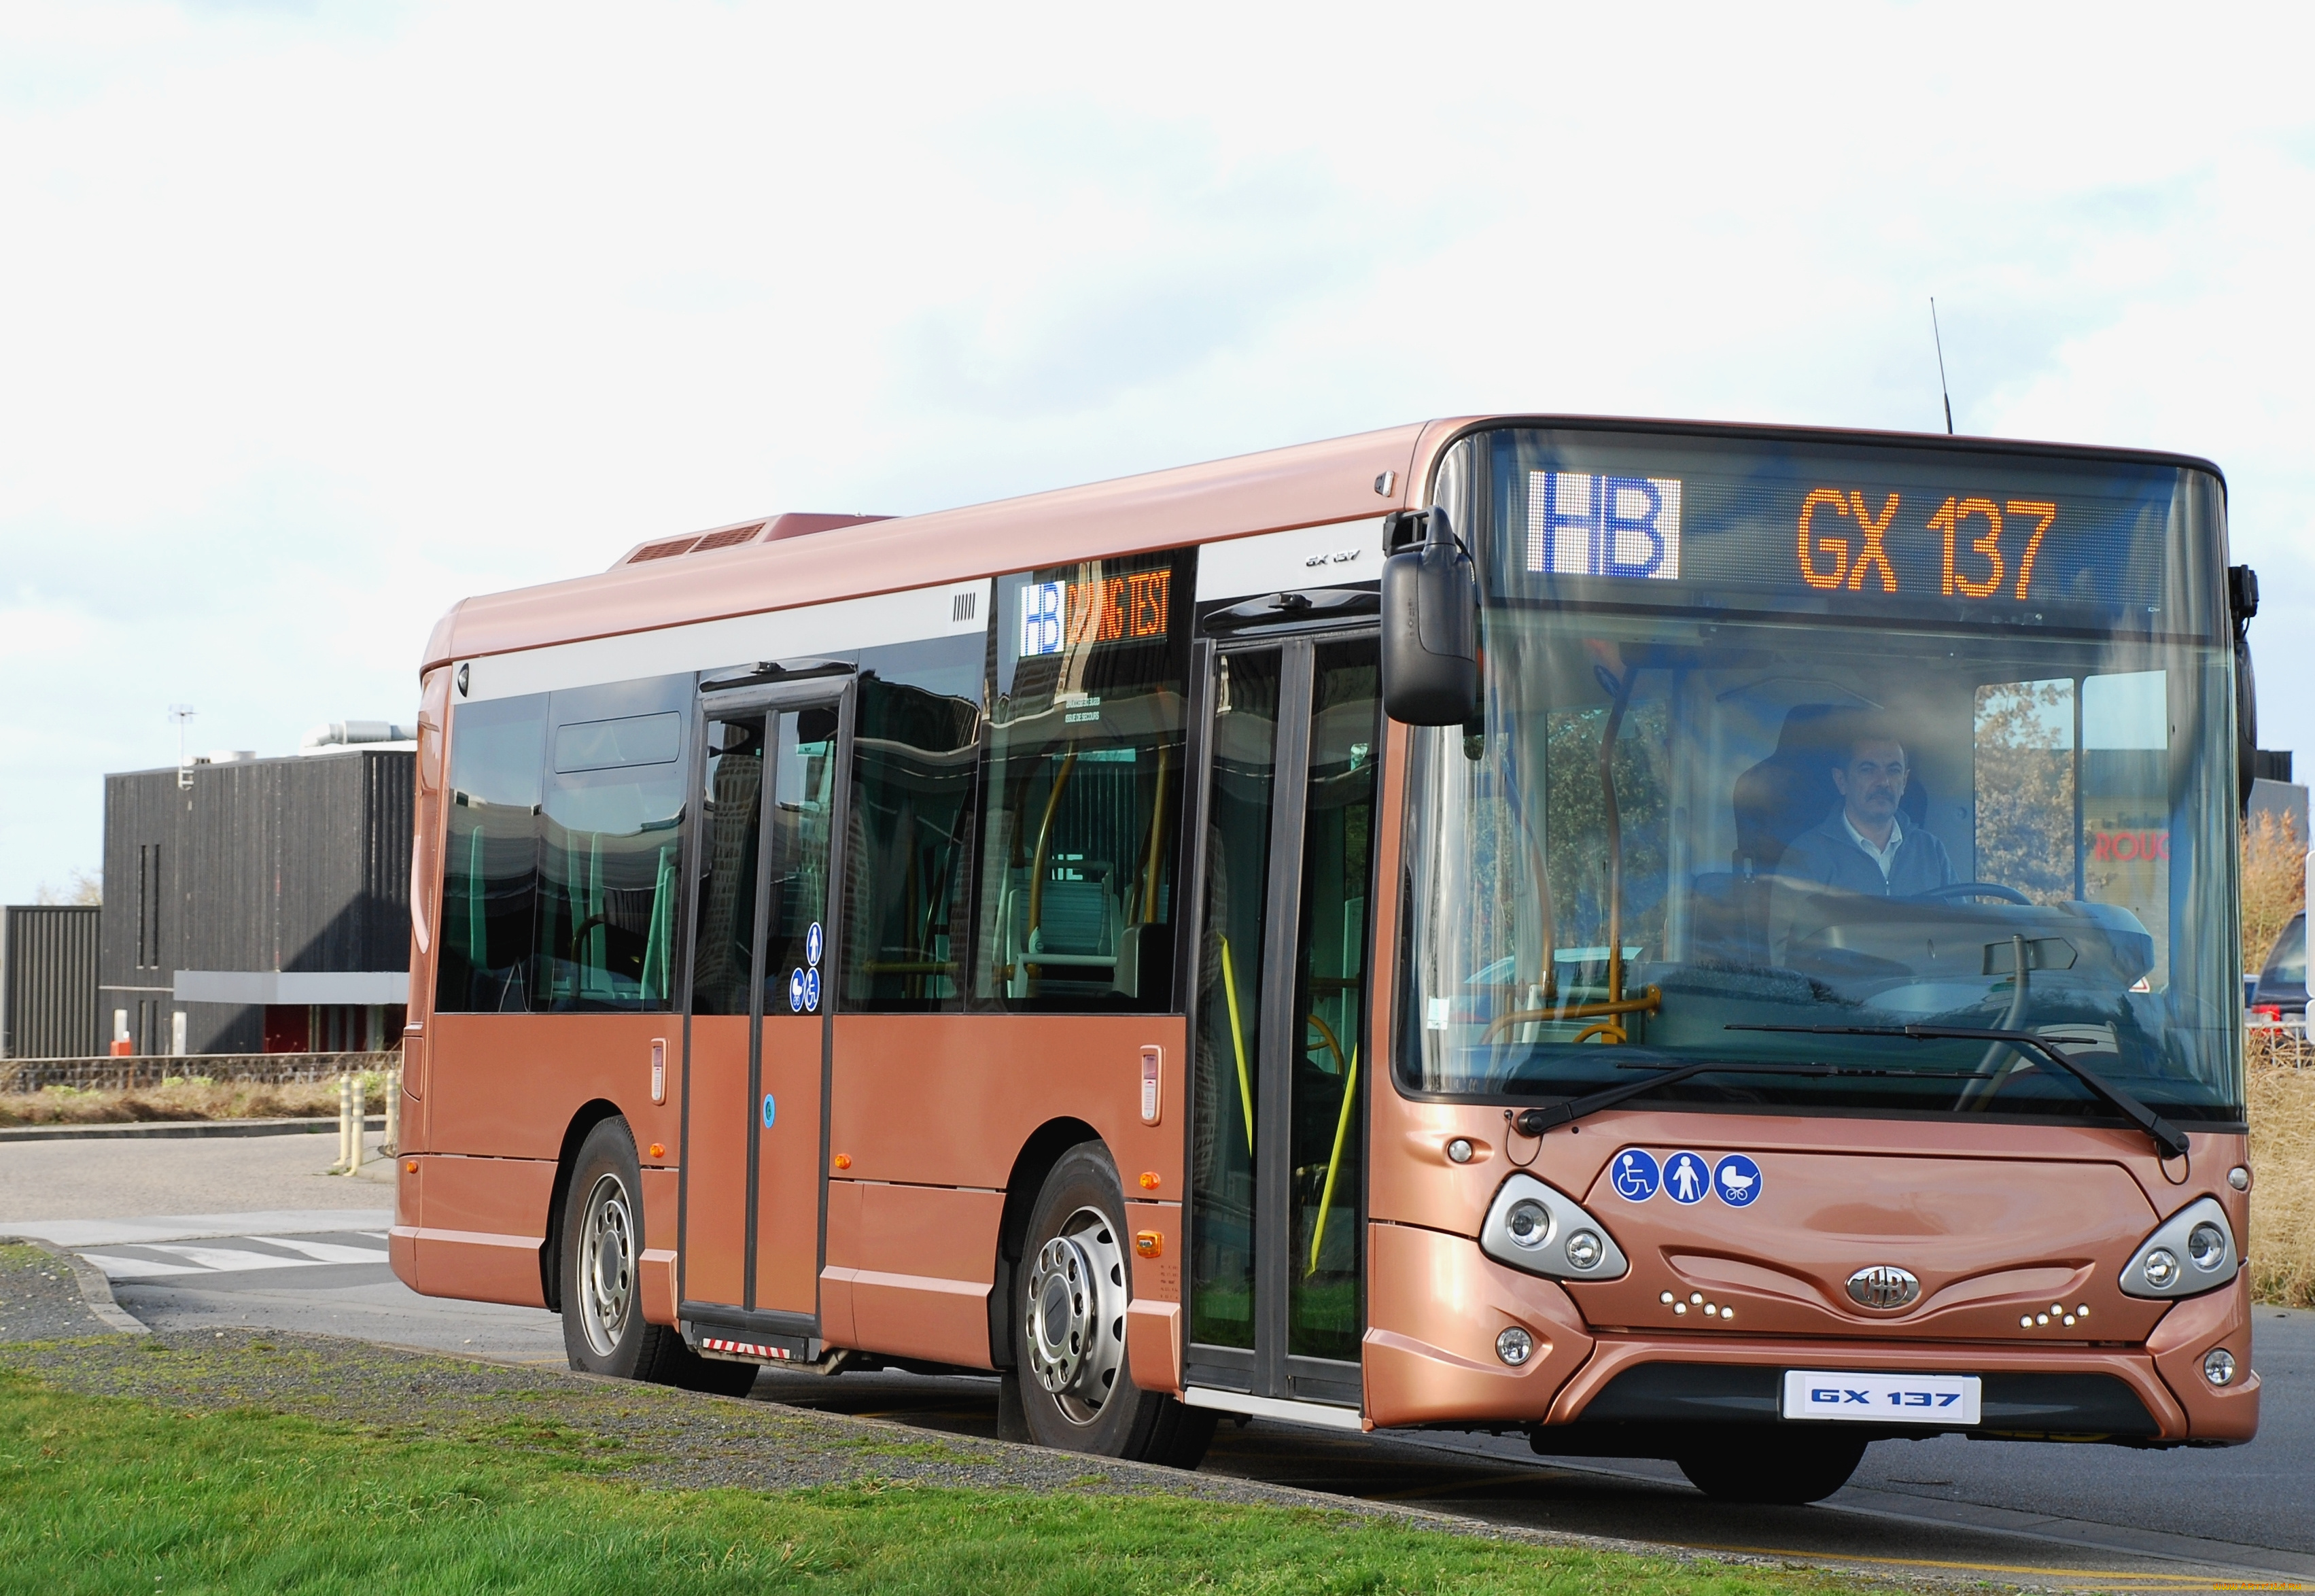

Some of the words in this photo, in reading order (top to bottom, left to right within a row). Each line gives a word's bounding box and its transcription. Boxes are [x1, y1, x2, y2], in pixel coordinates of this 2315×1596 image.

[1305, 554, 1328, 566] GX
[1332, 549, 1361, 563] 137
[1543, 471, 1663, 579] HB
[1798, 488, 1900, 593] GX
[1926, 496, 2055, 600] 137
[1024, 581, 1060, 657] HB
[1127, 570, 1171, 637] TEST
[1811, 1388, 1870, 1404] GX
[1887, 1391, 1961, 1407] 137
